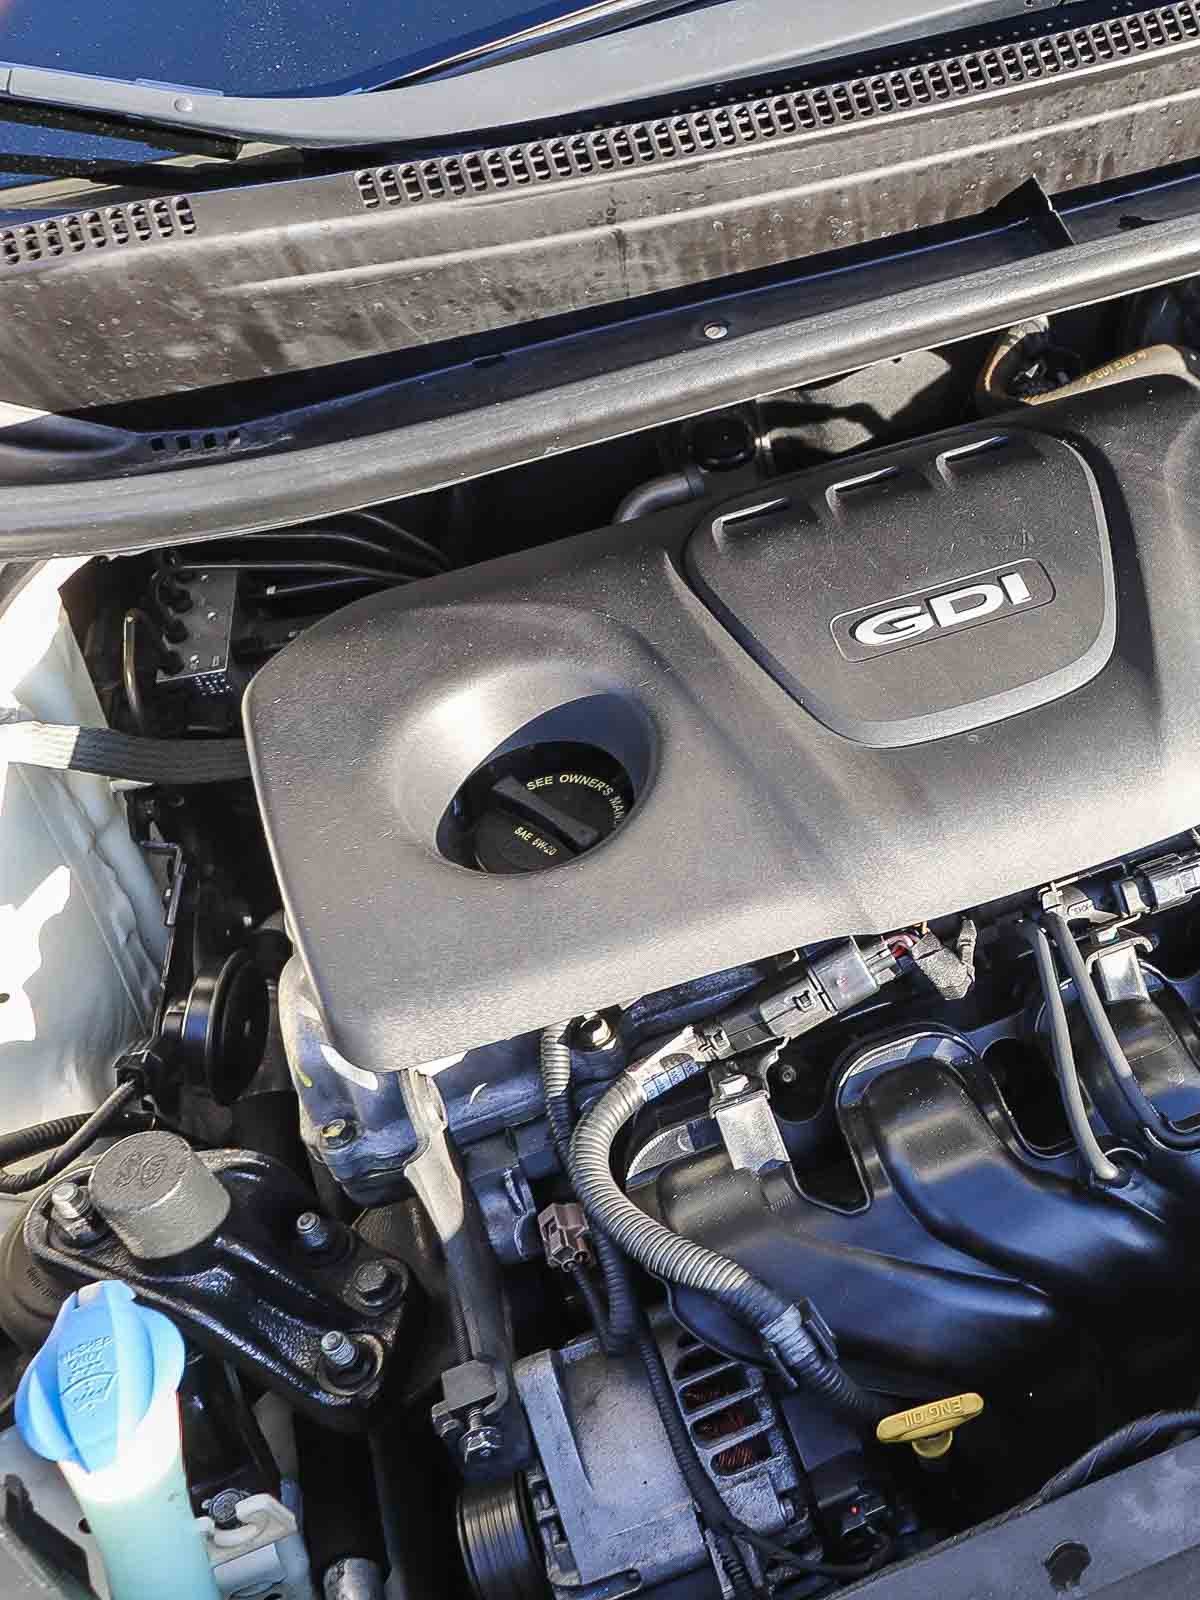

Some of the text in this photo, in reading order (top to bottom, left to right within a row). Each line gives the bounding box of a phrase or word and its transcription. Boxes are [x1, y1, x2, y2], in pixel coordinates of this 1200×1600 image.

[852, 572, 1032, 645] GDI
[526, 775, 553, 790] SEE
[559, 774, 614, 796] OWNER'S
[514, 826, 533, 841] SAE
[904, 1399, 961, 1427] ENG OIL
